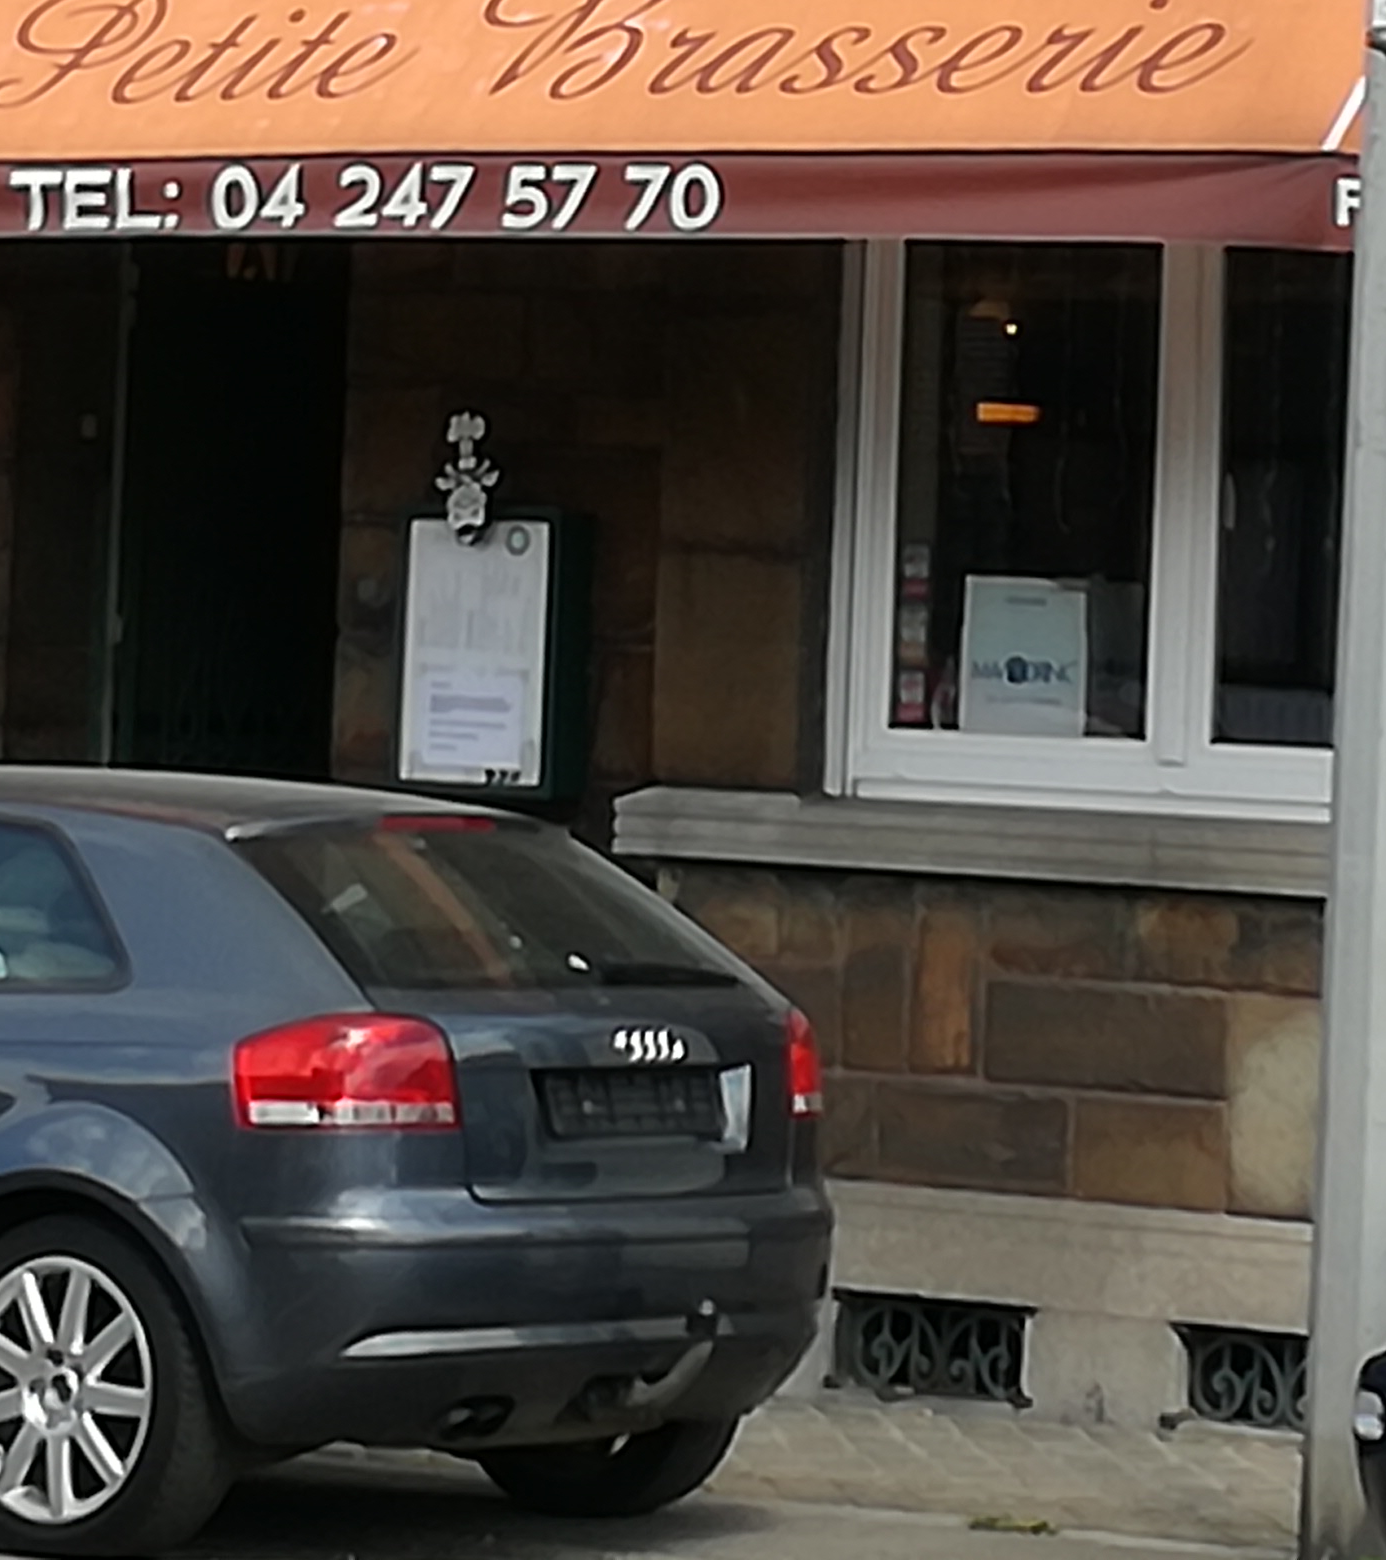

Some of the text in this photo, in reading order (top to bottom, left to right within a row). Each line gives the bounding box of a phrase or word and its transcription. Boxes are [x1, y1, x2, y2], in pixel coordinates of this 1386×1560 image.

[10, 163, 722, 231] TEL: 04 247 57 70
